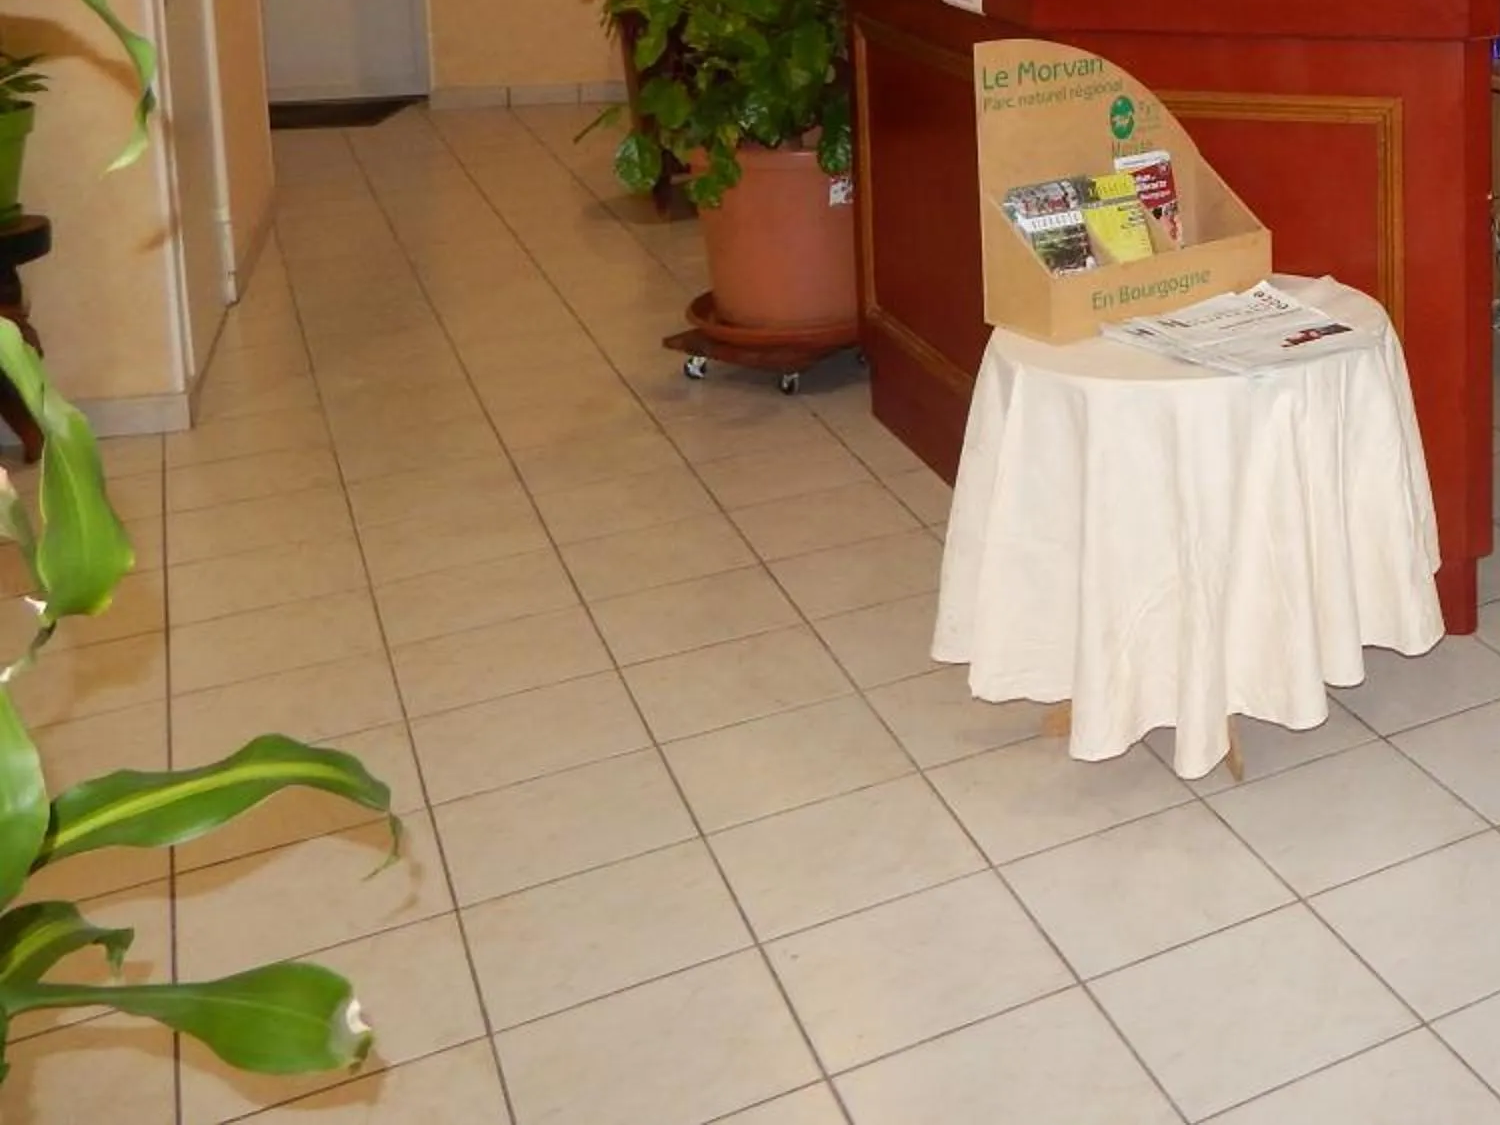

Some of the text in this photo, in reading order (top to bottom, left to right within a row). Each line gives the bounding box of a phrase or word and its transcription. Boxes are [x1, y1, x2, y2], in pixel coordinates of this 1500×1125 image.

[982, 58, 1105, 90] Le Morvan
[983, 79, 1123, 114] Parc naturel régional
[1091, 270, 1211, 311] En Bourgogne
